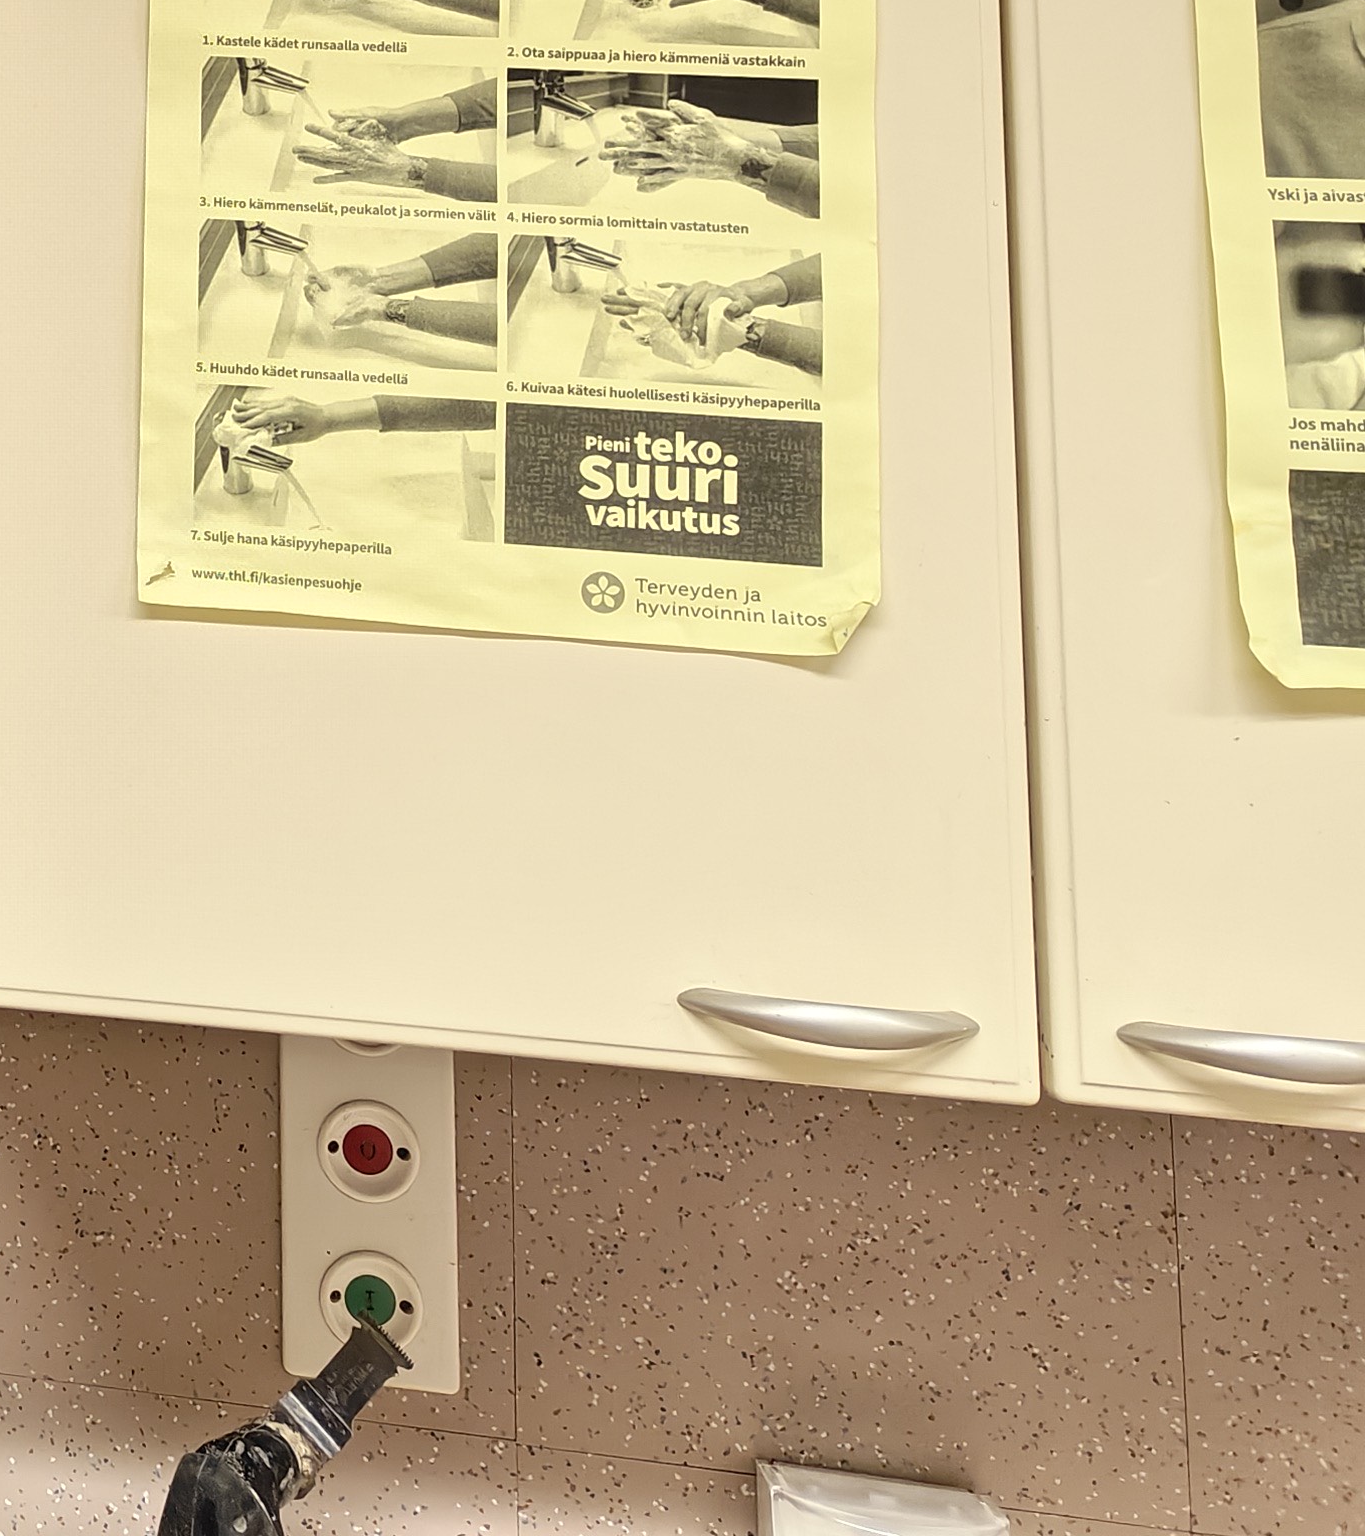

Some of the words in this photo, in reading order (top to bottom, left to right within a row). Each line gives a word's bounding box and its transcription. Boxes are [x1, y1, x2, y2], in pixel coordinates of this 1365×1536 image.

[202, 34, 214, 46] 1.
[216, 35, 262, 48] Kastele
[263, 36, 299, 49] kädet
[301, 39, 360, 52] runsaalla
[361, 40, 408, 53] vedellä
[507, 46, 519, 58] 2.
[521, 46, 545, 58] Ota
[547, 47, 606, 62] saippuaa
[607, 49, 620, 64] ja
[623, 49, 657, 63] hiero
[659, 50, 730, 65] kämmeniä
[732, 54, 806, 68] vastakkain
[1267, 188, 1300, 201] Yski
[1303, 188, 1319, 204] ja
[1322, 189, 1365, 203] aivas
[199, 196, 211, 208] 3.
[213, 196, 247, 209] Hiero
[249, 197, 338, 216] kämmenselät,
[340, 203, 398, 217] peukalot
[398, 204, 411, 219] ja
[413, 207, 466, 220] sormien
[467, 209, 497, 222] välit
[506, 211, 519, 223] 4.
[521, 211, 557, 225] Hiero
[559, 215, 604, 227] sormia
[606, 215, 668, 230] lomittain
[669, 221, 749, 235] vastatusten
[195, 361, 207, 373] 5.
[209, 362, 259, 376] Huuhdo
[262, 364, 299, 379] kädet
[300, 369, 360, 382] runsaalla
[362, 372, 408, 385] vedellä
[506, 380, 518, 392] 6.
[521, 381, 565, 395] Kuivaa
[567, 383, 607, 398] kätesi
[609, 386, 690, 403] huolellisesti
[692, 391, 821, 412] käsipyyhepaperilla
[1288, 417, 1317, 431] Jos
[585, 435, 631, 455] Pieni
[1290, 437, 1365, 453] nenäliina
[577, 454, 739, 506] Suuri
[585, 499, 740, 536] vaikutus
[190, 529, 201, 541] 7.
[203, 530, 235, 546] Sulje
[236, 532, 268, 546] hana
[270, 534, 392, 555] käsipyyhepaperilla
[191, 569, 362, 593] www.thl.fi/kasienpesuohje
[635, 577, 738, 602] Terveyden
[742, 590, 761, 605] ja
[636, 598, 765, 624] hyvinvoinnin
[771, 609, 828, 628] laitos
